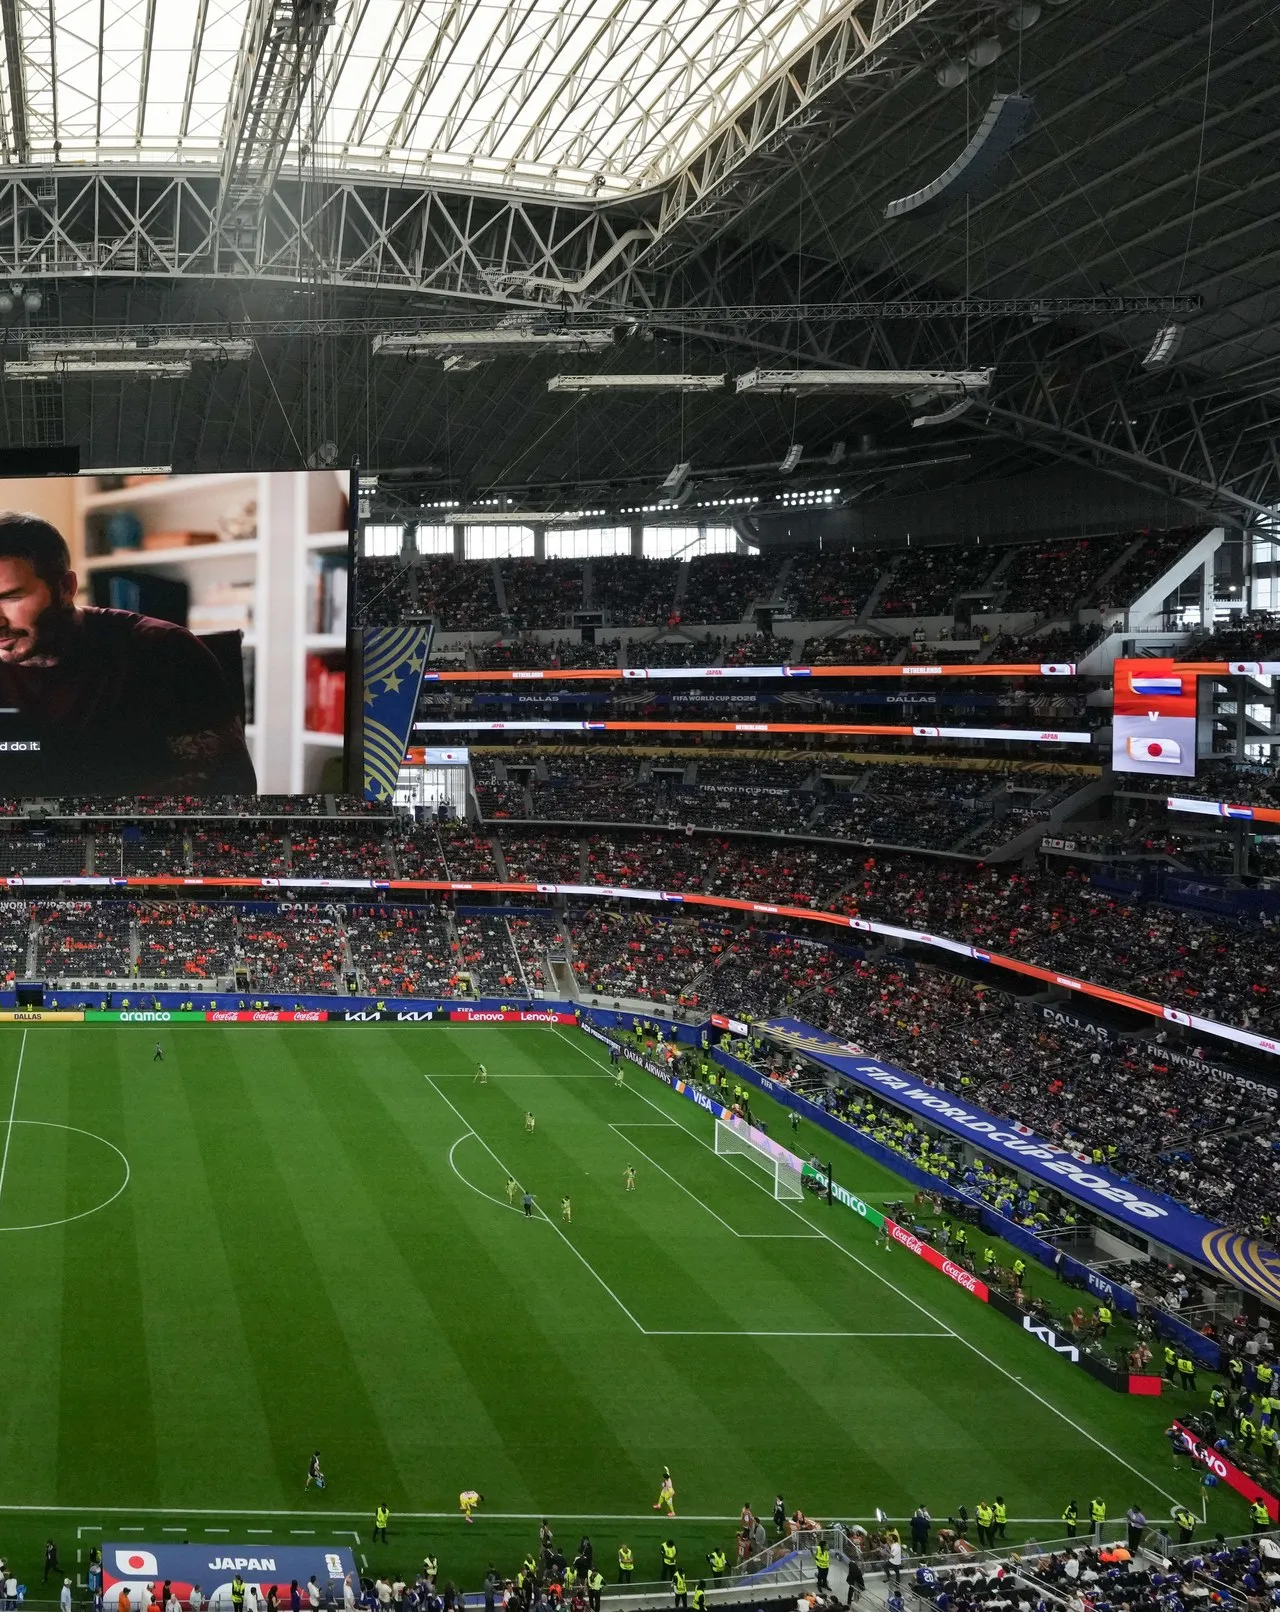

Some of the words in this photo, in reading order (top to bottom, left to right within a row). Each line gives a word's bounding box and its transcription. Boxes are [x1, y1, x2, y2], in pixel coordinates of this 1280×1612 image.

[10, 742, 27, 751] do
[29, 742, 41, 751] it.
[13, 1013, 41, 1021] DALLAS
[120, 1012, 171, 1021] aramco
[212, 1012, 238, 1021] Coca-Cola
[253, 1012, 279, 1021] Coca-Cola
[293, 1012, 319, 1021] Coca-Cola
[345, 1012, 380, 1021] KIA
[397, 1012, 433, 1021] KIA
[468, 1012, 504, 1021] Lenovo
[521, 1012, 558, 1023] Lenovo
[623, 1048, 644, 1068] QATAR
[644, 1063, 671, 1085] AIRWAYS
[1147, 1045, 1170, 1061] FIFA
[1235, 1076, 1279, 1099] 2026
[760, 1077, 773, 1091] FIFA
[692, 1090, 714, 1114] VISA
[856, 1066, 910, 1091] FIFA
[902, 1089, 997, 1132] WORLD
[988, 1132, 1055, 1160] CUP
[1040, 1161, 1169, 1219] 2026
[892, 1226, 924, 1256] Coca-Cola
[942, 1260, 975, 1293] Coca-Cola
[1089, 1272, 1113, 1295] FIFA
[1023, 1316, 1079, 1362] KIA
[208, 1557, 277, 1571] JAPAN
